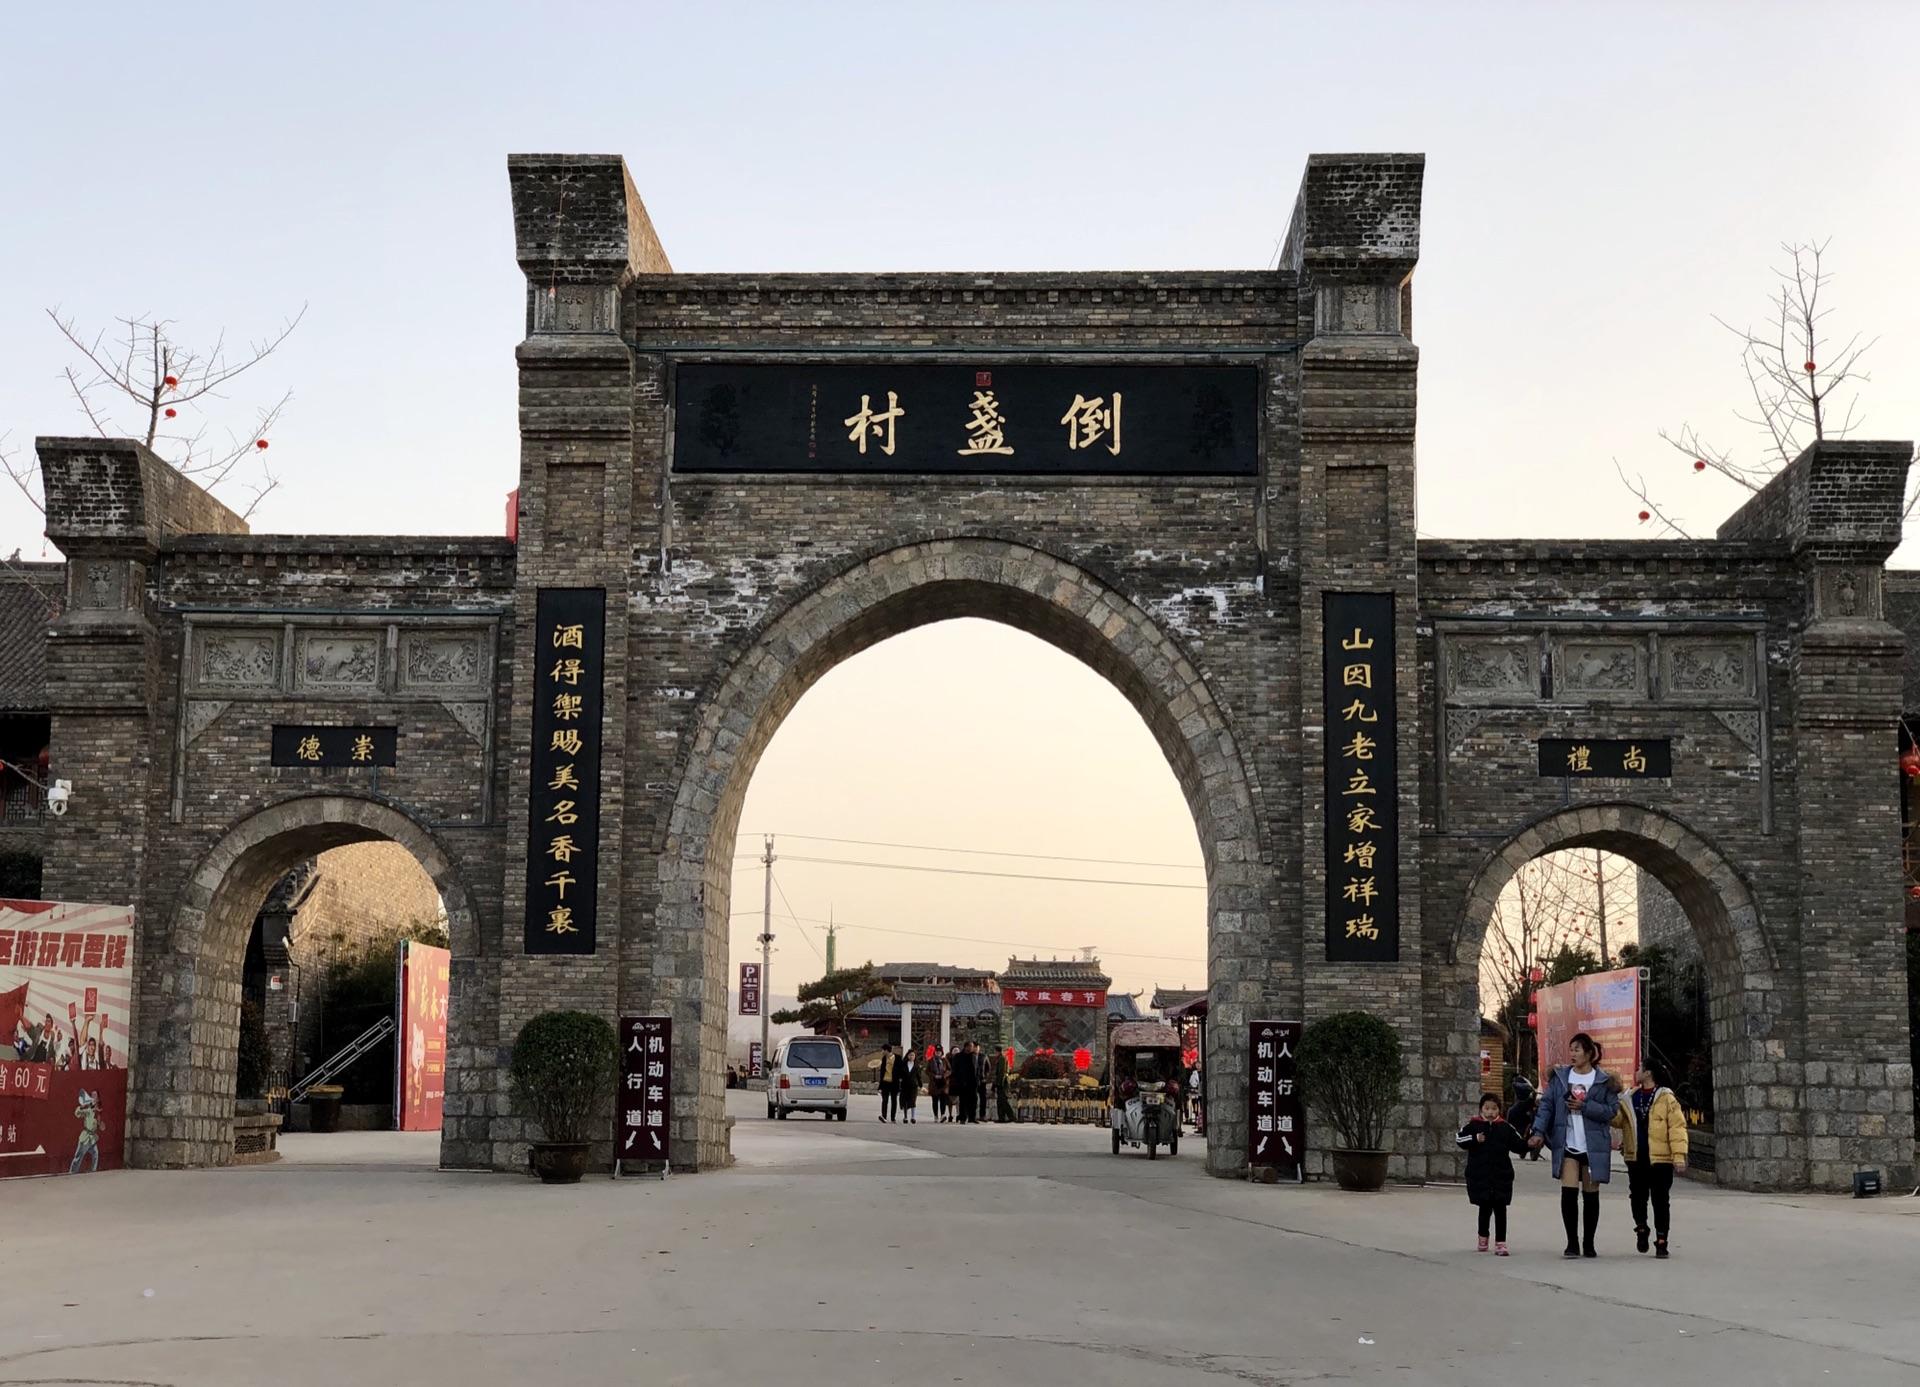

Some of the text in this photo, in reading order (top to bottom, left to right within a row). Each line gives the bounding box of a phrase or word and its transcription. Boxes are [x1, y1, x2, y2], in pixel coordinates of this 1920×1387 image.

[746, 966, 755, 977] P
[1015, 990, 1096, 1003] 欢度春节
[626, 1036, 643, 1127] 人行道
[646, 1036, 664, 1127] 机动车道
[1256, 1042, 1273, 1132] 机动车道
[1277, 1042, 1293, 1132] 人行道
